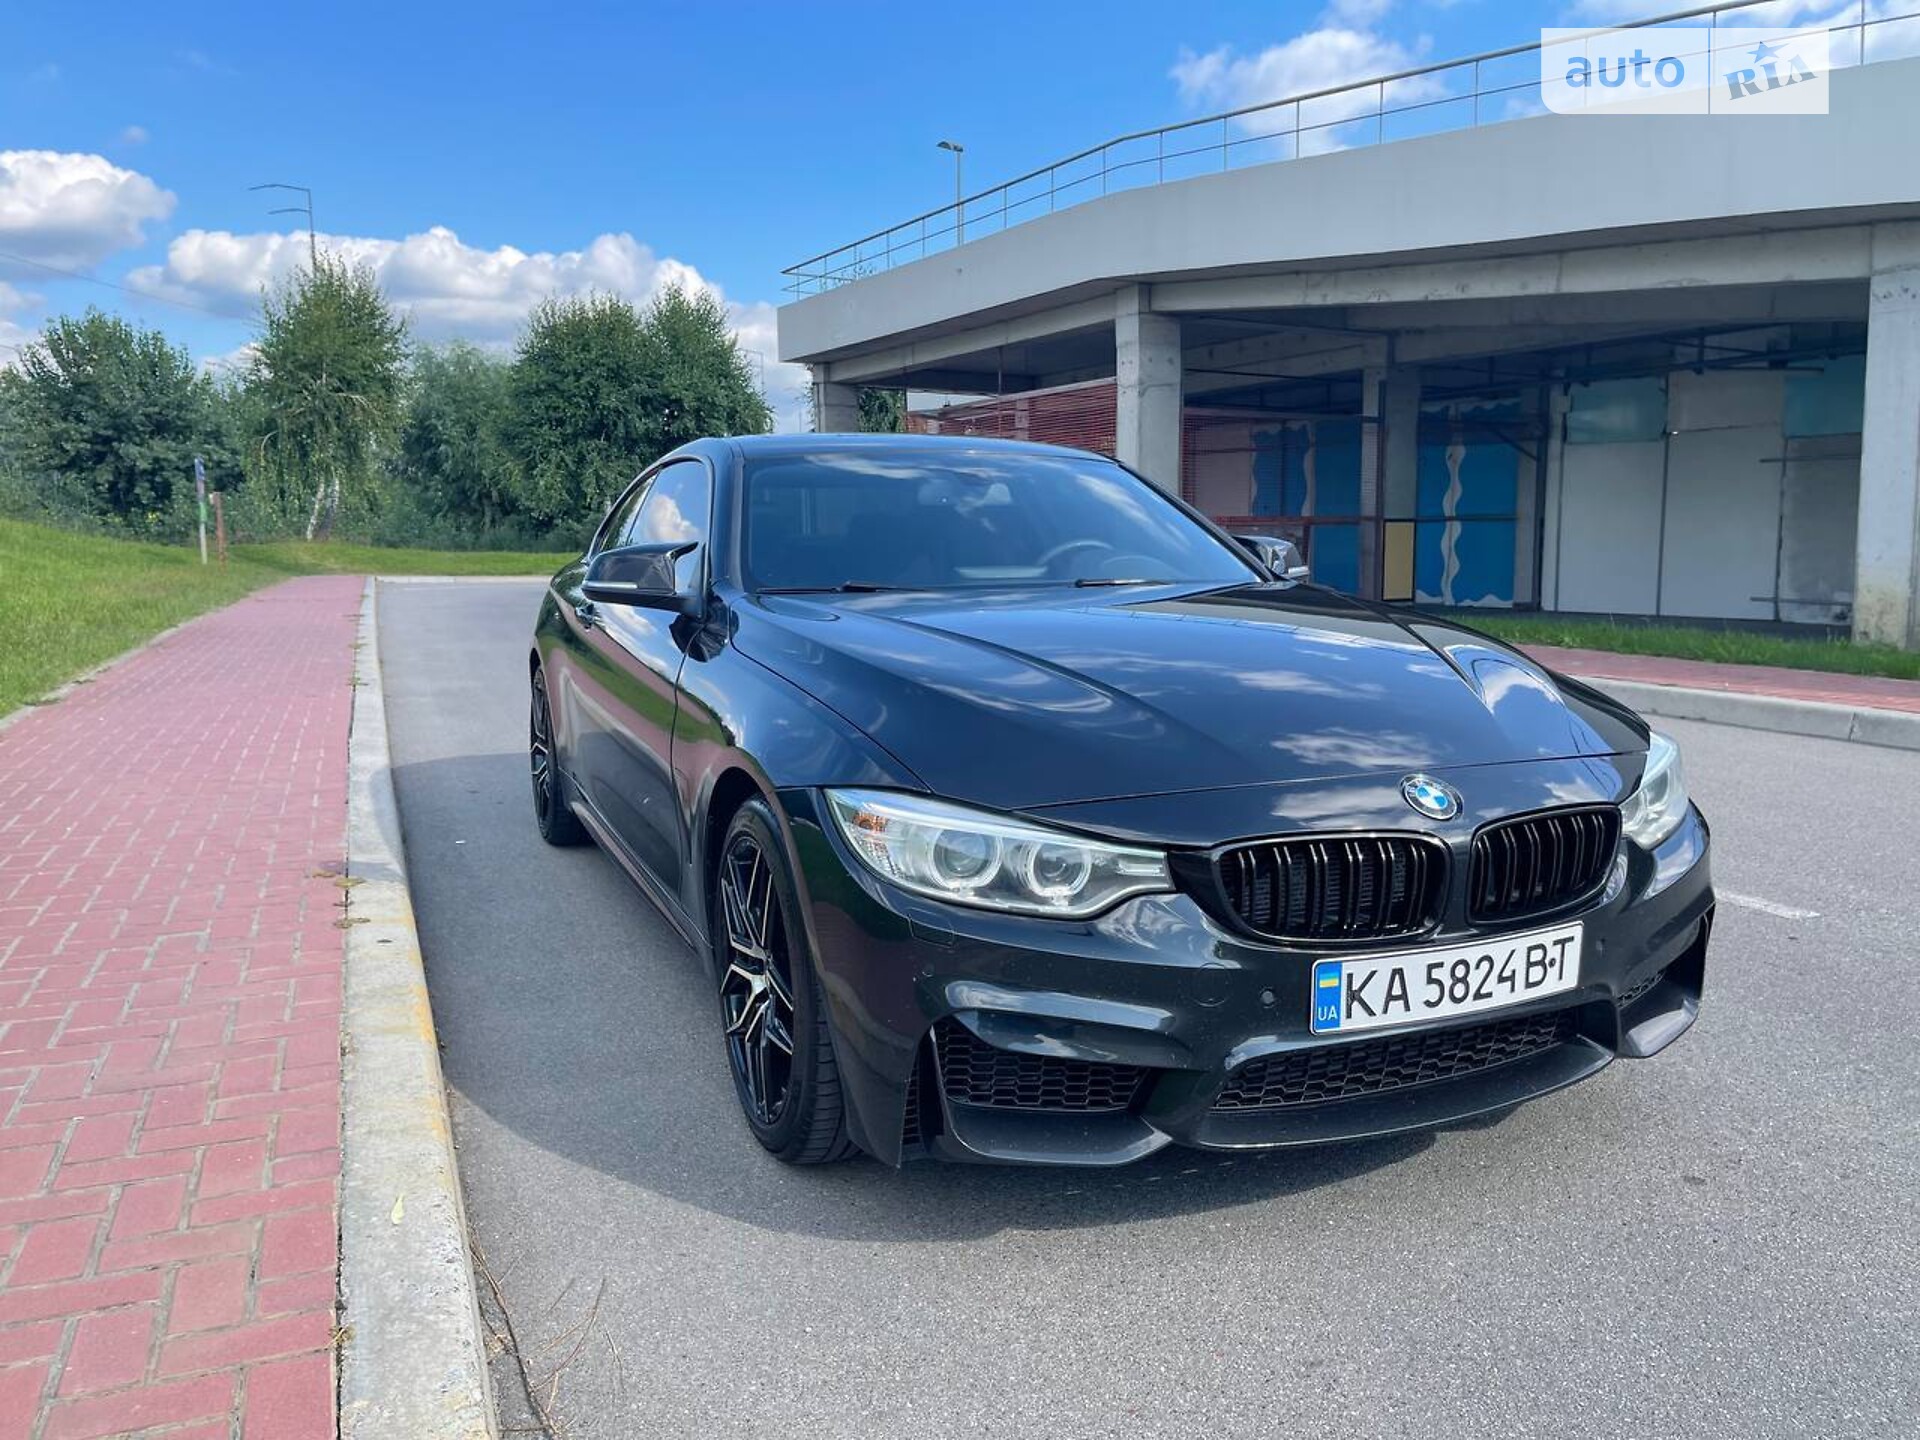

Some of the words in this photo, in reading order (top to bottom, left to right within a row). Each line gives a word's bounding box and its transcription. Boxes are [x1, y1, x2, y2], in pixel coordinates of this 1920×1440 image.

[1345, 967, 1411, 1019] KA
[1423, 949, 1516, 1008] 5824
[1317, 1006, 1338, 1021] UA
